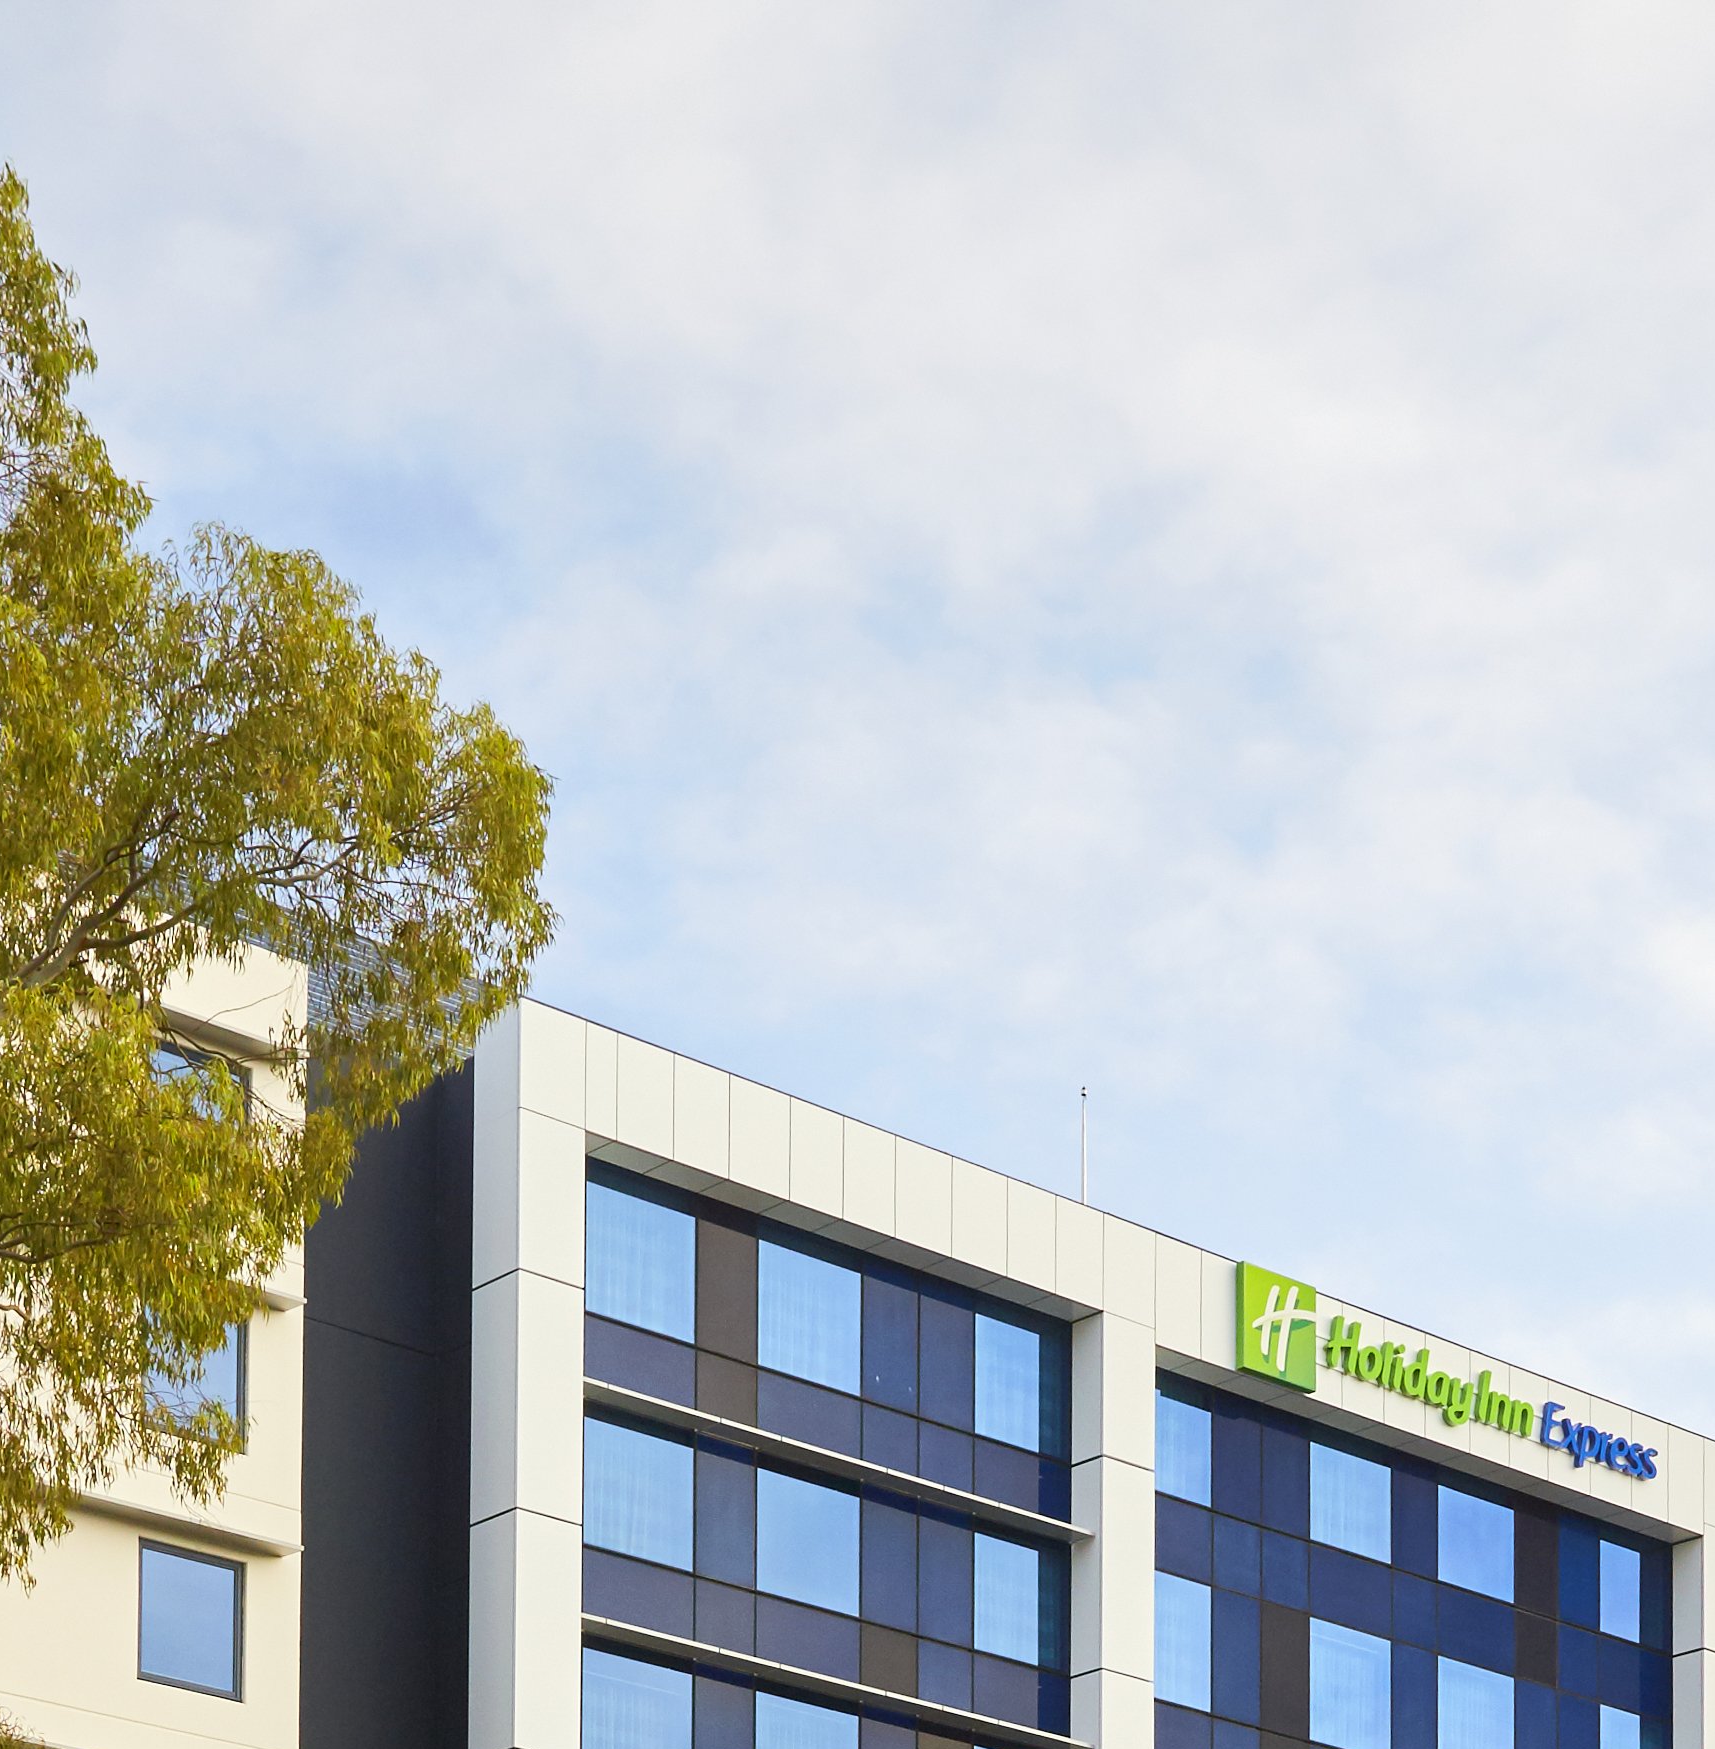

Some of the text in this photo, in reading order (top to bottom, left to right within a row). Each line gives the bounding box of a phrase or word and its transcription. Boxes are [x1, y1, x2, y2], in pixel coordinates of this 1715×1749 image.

[1325, 1315, 1659, 1482] Holiday Inn Express
